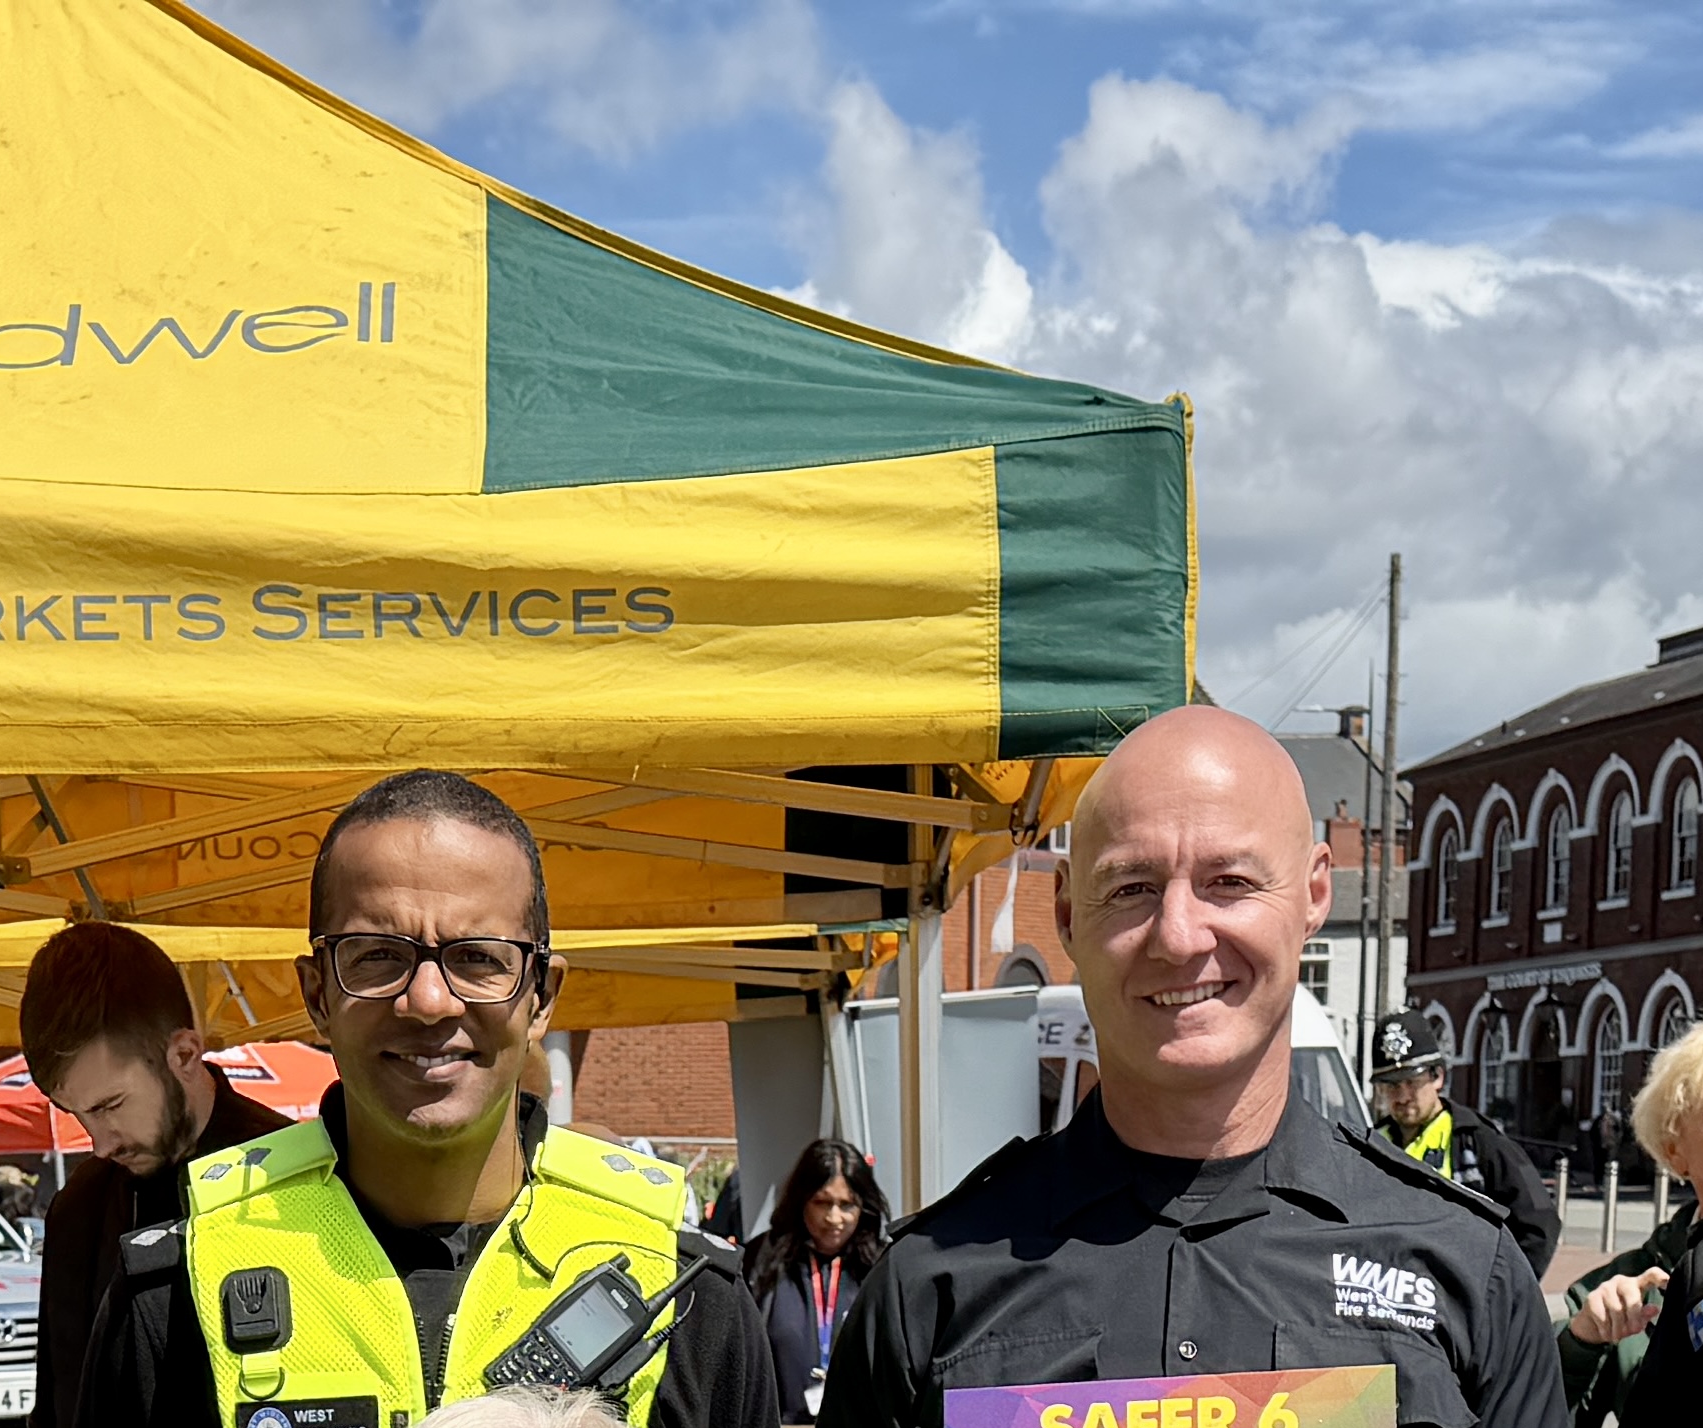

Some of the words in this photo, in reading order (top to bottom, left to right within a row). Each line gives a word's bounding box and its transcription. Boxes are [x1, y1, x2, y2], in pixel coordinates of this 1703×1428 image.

[252, 583, 675, 642] SERVICES
[1333, 1253, 1436, 1307] WMFS
[19, 1389, 35, 1409] F
[294, 1408, 335, 1423] WEST
